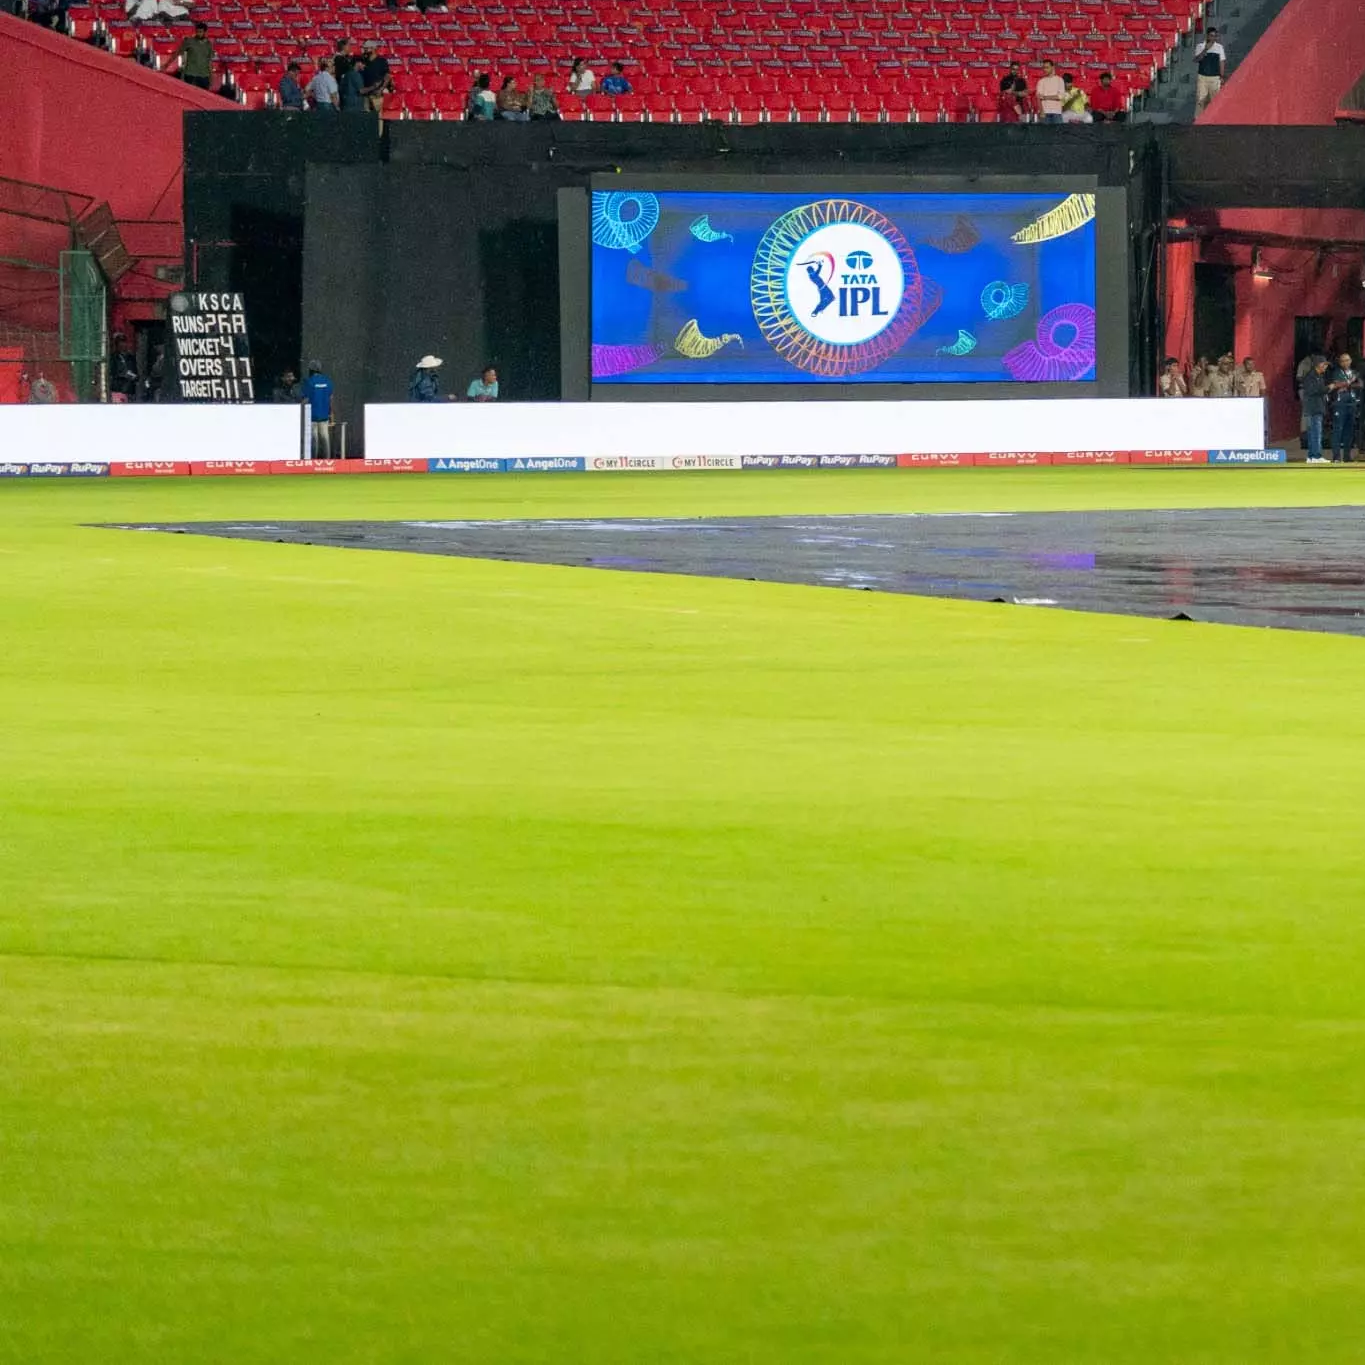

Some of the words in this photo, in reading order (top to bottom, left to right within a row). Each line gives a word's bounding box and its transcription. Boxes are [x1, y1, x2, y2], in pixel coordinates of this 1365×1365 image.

[841, 275, 877, 285] TATA
[838, 289, 888, 316] IPL
[172, 315, 205, 333] RUNS
[177, 338, 220, 355] WICKET
[180, 358, 222, 376] OVERS
[180, 380, 212, 397] TARGET
[743, 456, 775, 466] RuPay
[781, 456, 812, 466] RuPay
[820, 455, 852, 466] RuPay
[859, 455, 890, 465] RuPay
[1228, 451, 1280, 462] AngelOne
[0, 463, 23, 475] uPay
[31, 463, 68, 474] RuPay
[71, 462, 103, 474] RuPay
[448, 459, 498, 471] AngelOne
[527, 458, 578, 469] AngelOne
